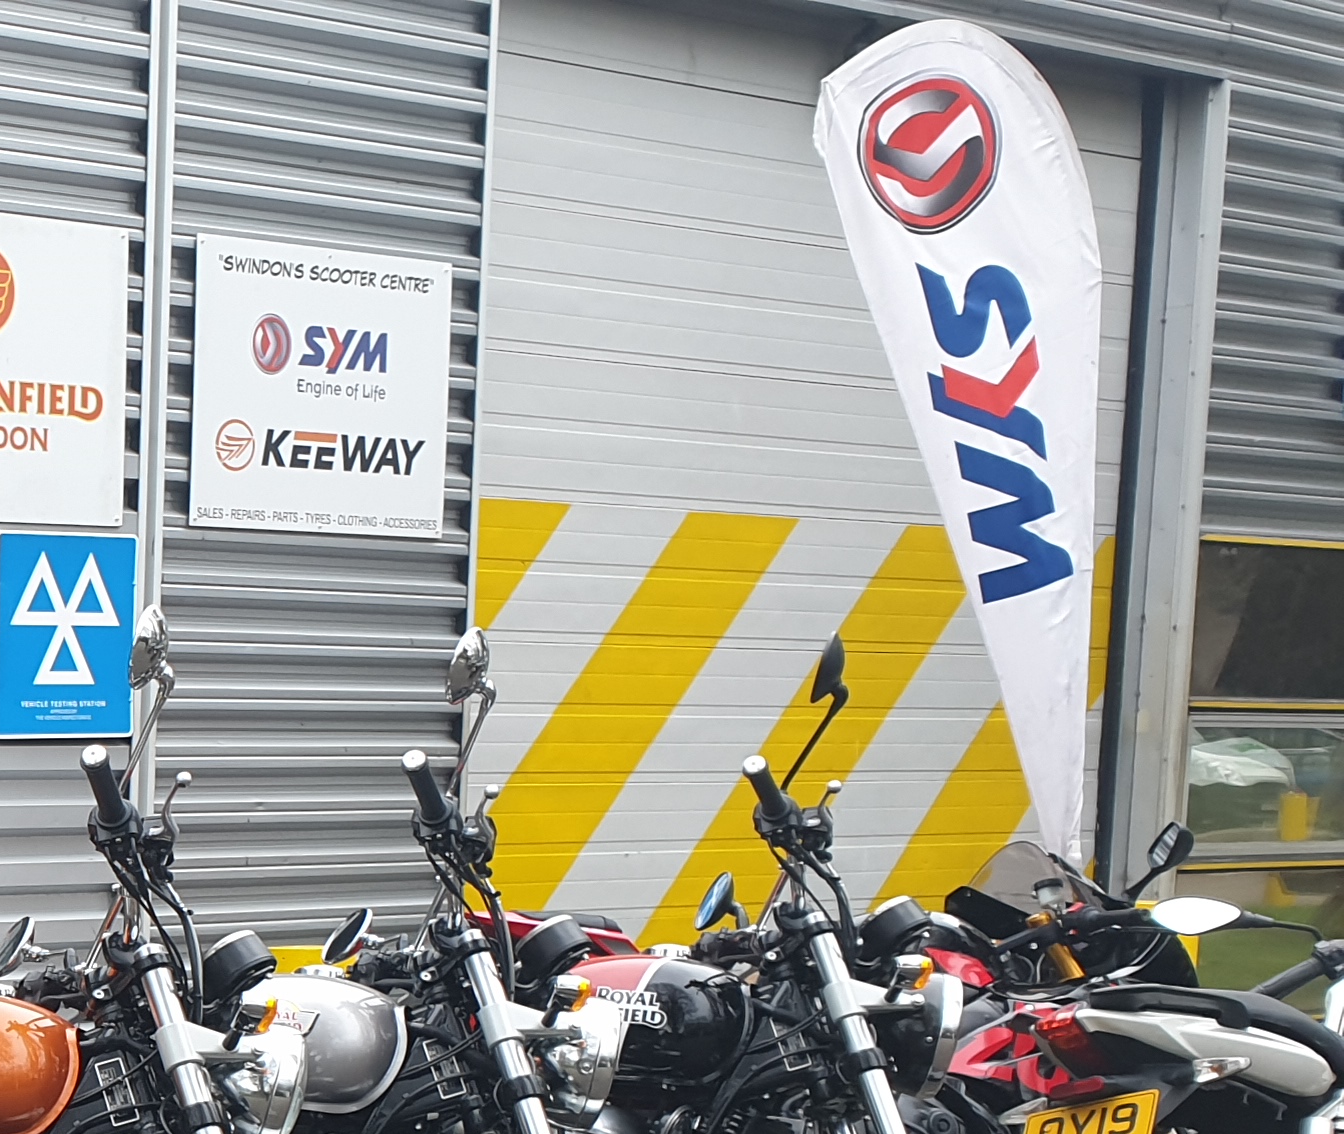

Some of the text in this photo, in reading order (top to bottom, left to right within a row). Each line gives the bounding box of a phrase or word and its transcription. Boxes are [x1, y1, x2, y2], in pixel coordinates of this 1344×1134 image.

[309, 265, 376, 288] SCOOTER
[298, 325, 388, 374] SYM
[297, 378, 386, 401] Engine of Life
[915, 261, 1074, 605] SYM
[261, 428, 426, 476] KEEWAY
[196, 507, 438, 531] SALES REPAIRS PARTS TYRES CLOTHING ACCESSORIES
[20, 700, 107, 708] VEHICLE TESTING STATION
[597, 988, 659, 1007] ROYAL
[618, 1008, 667, 1027] IELD
